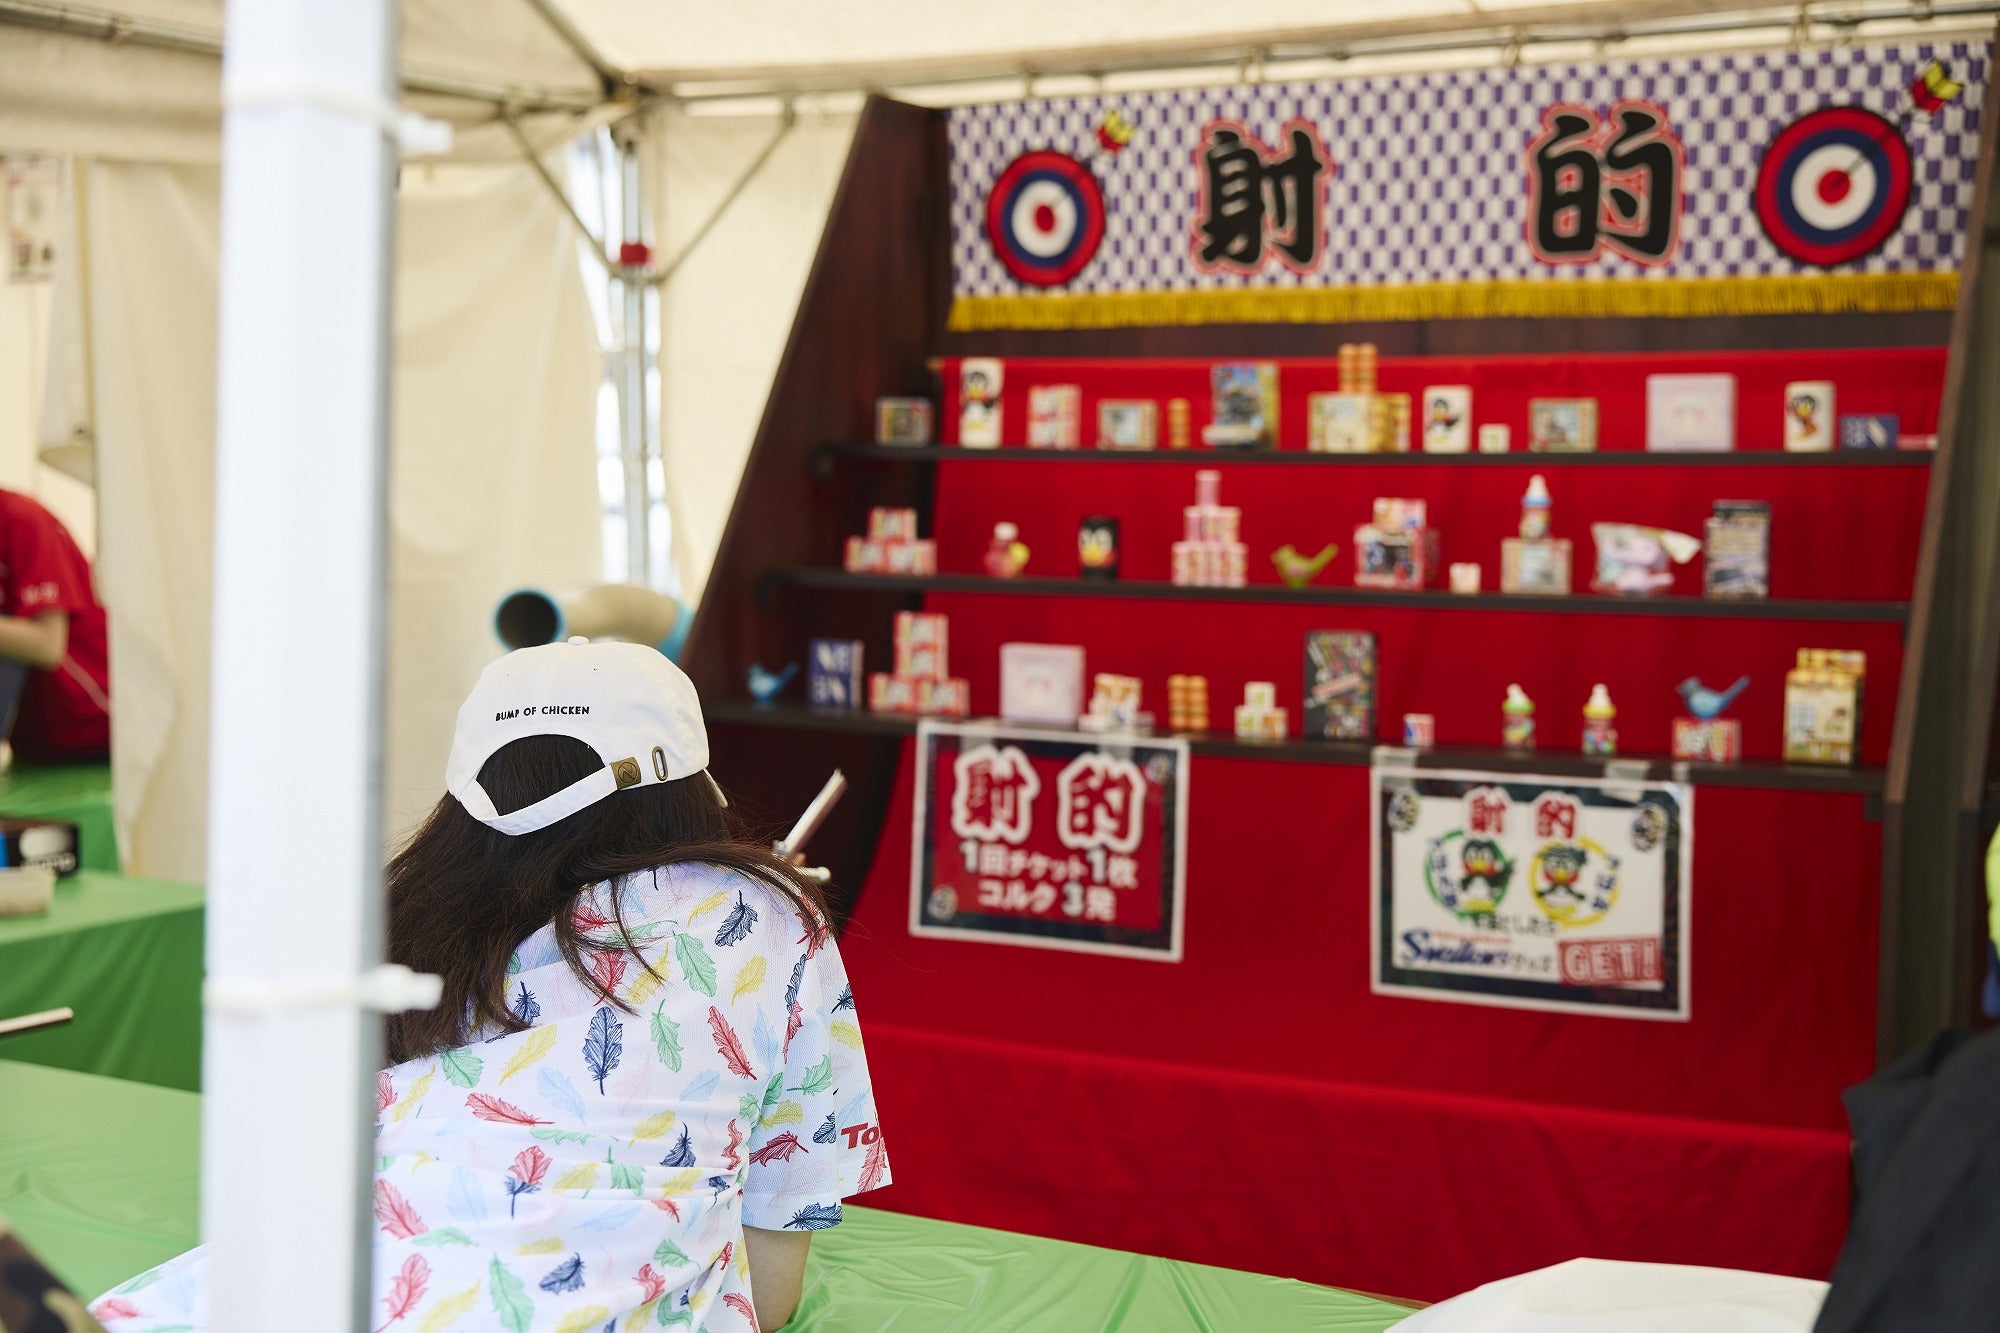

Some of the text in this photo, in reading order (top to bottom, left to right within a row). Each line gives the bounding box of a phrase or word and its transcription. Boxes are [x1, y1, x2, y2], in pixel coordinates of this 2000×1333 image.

[495, 705, 590, 722] BUMP OF CHICKEN
[954, 746, 1144, 850] 射的
[1468, 792, 1577, 839] 射的
